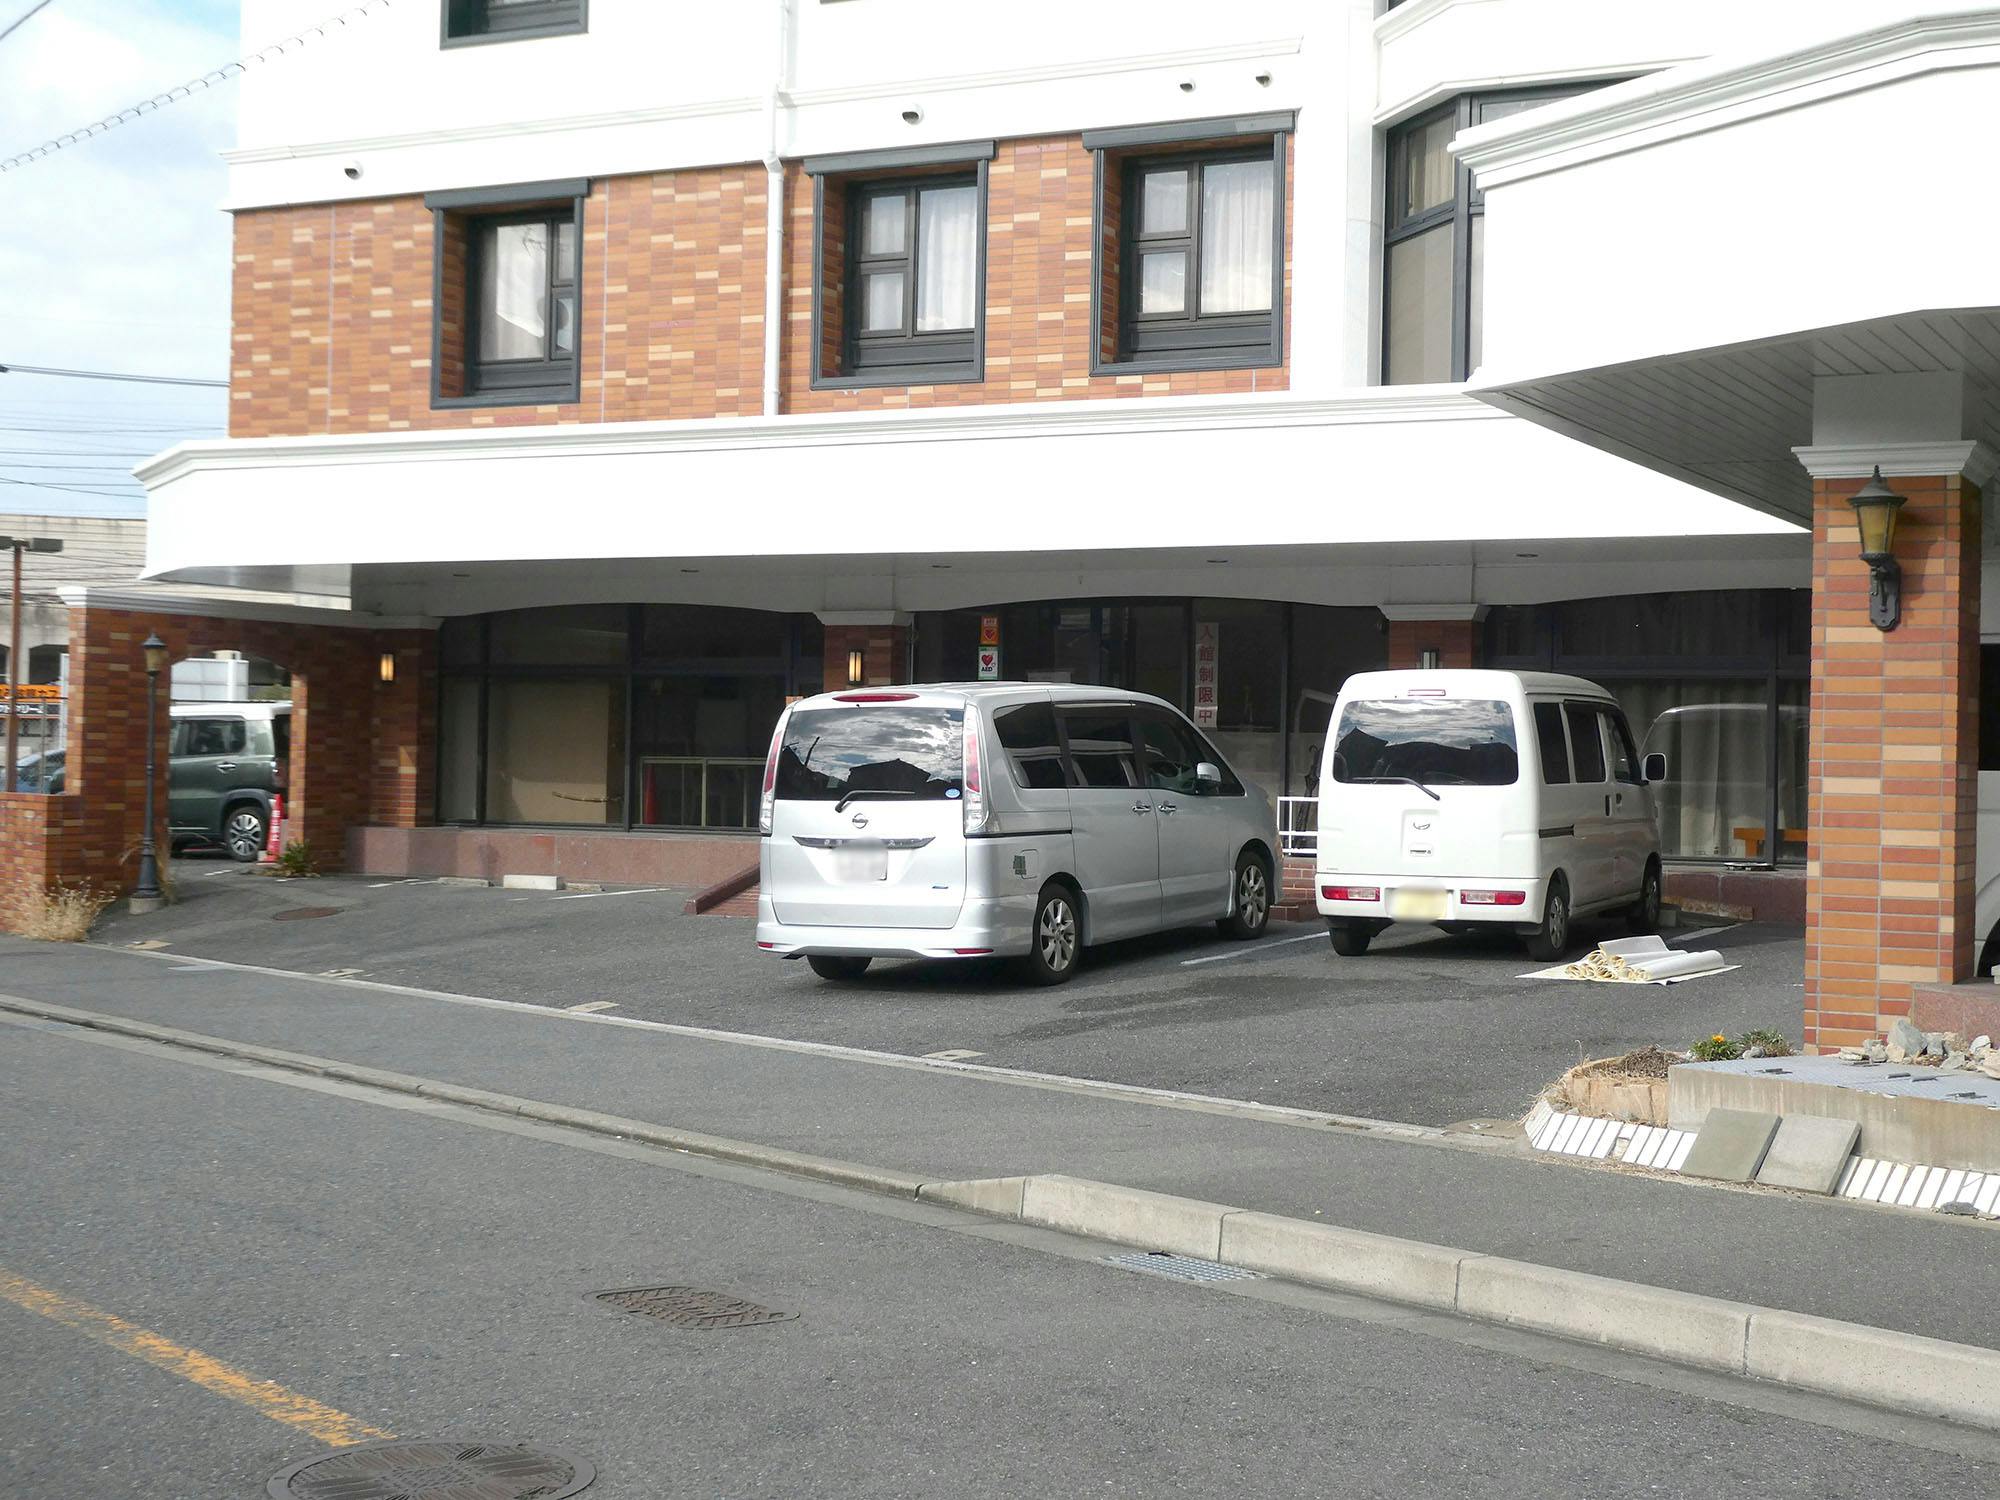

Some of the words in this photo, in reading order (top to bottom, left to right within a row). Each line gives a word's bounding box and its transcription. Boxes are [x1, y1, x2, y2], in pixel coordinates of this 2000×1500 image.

[1199, 624, 1216, 723] 入館制限中
